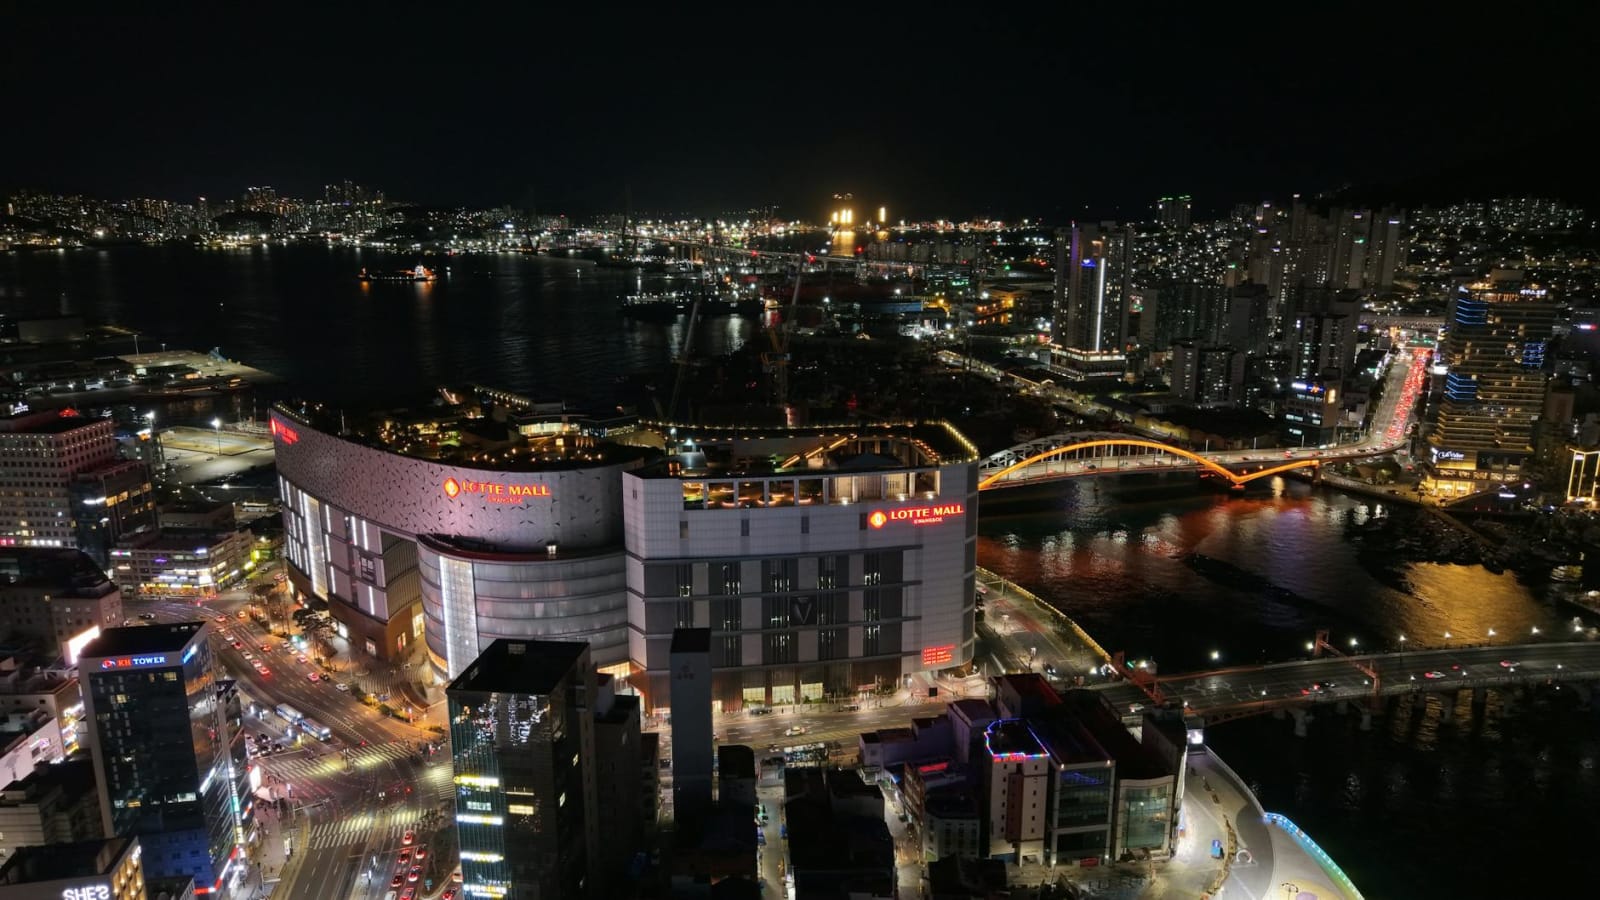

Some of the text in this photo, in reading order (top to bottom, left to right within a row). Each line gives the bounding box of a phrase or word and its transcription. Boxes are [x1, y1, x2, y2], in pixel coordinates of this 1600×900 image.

[461, 480, 550, 496] LOTTE MALL
[891, 504, 964, 520] LOTTE MALL
[117, 656, 165, 667] KH TOWER
